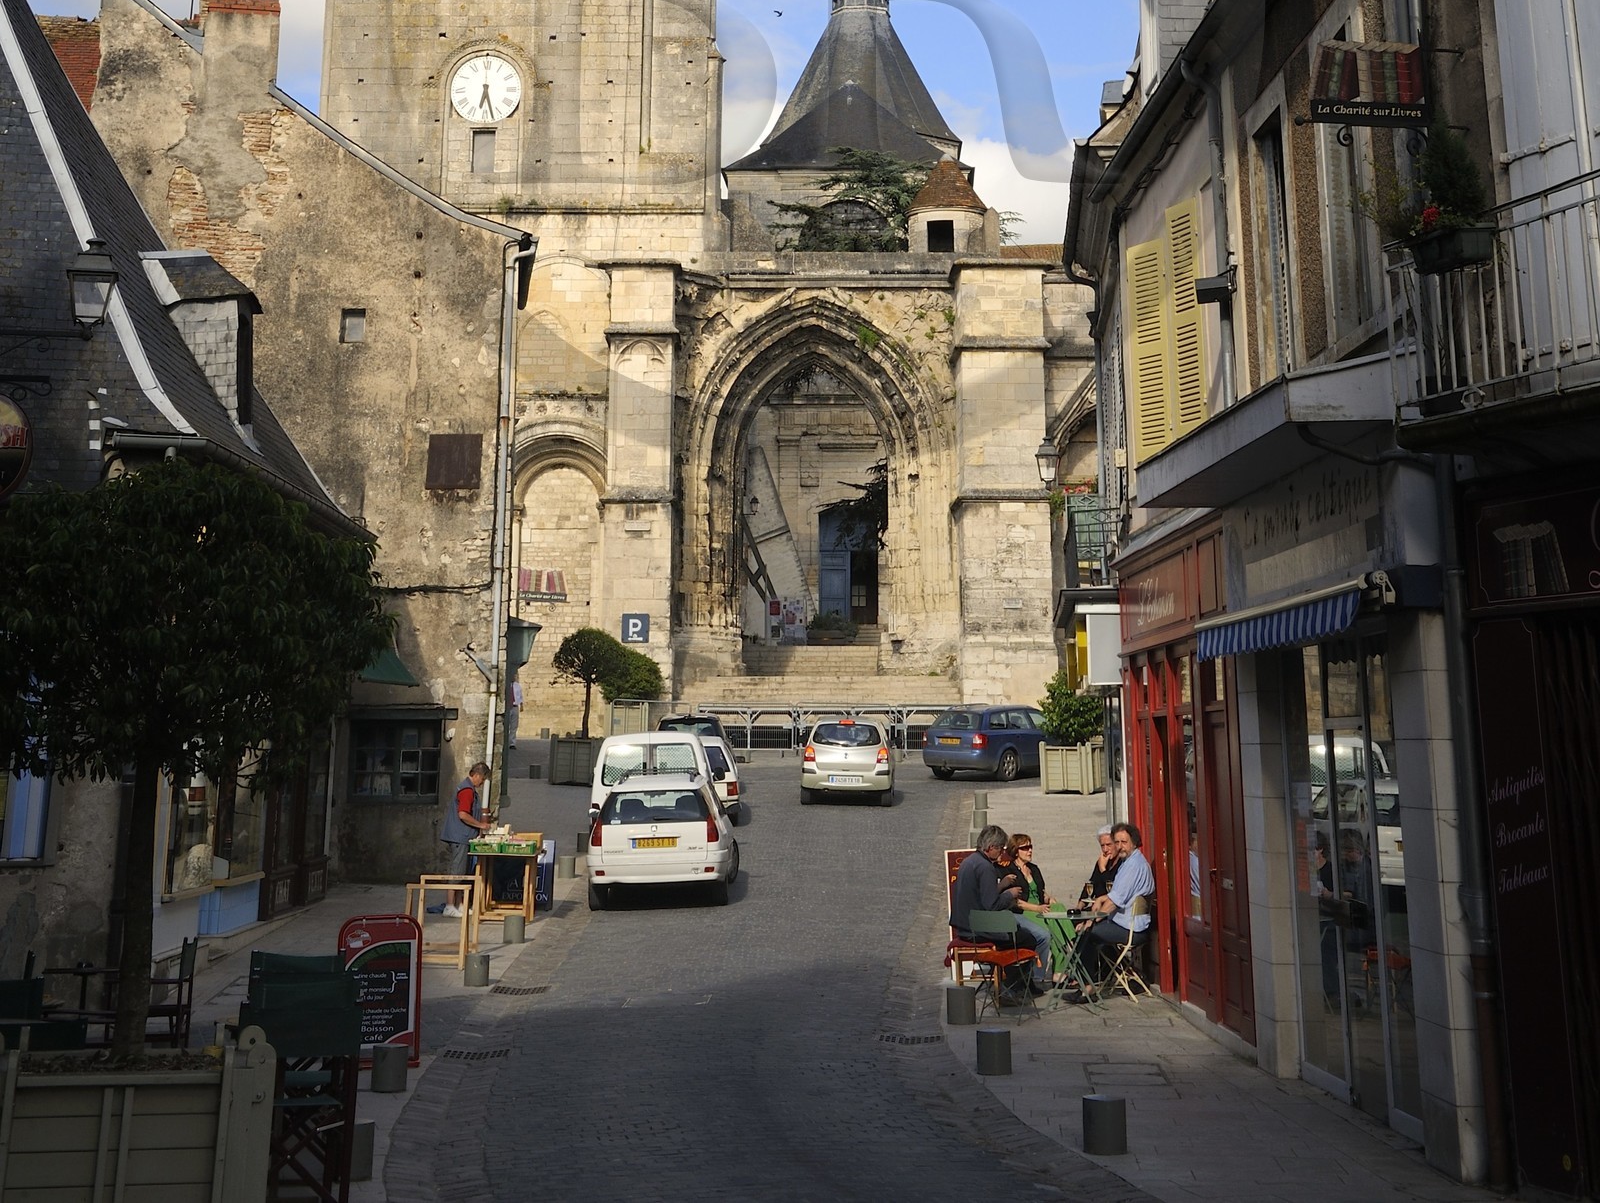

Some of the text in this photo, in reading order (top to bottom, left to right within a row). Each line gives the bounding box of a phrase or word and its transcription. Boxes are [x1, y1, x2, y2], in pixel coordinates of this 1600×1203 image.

[1317, 104, 1422, 118] La Charité sur Livres
[0, 425, 27, 447] SH
[1242, 467, 1373, 551] Le monde celtique
[628, 618, 643, 637] P
[1496, 810, 1545, 848] Brocante
[1498, 862, 1550, 894] Tableaux
[361, 1025, 394, 1033] Boisson
[364, 1033, 384, 1041] café
